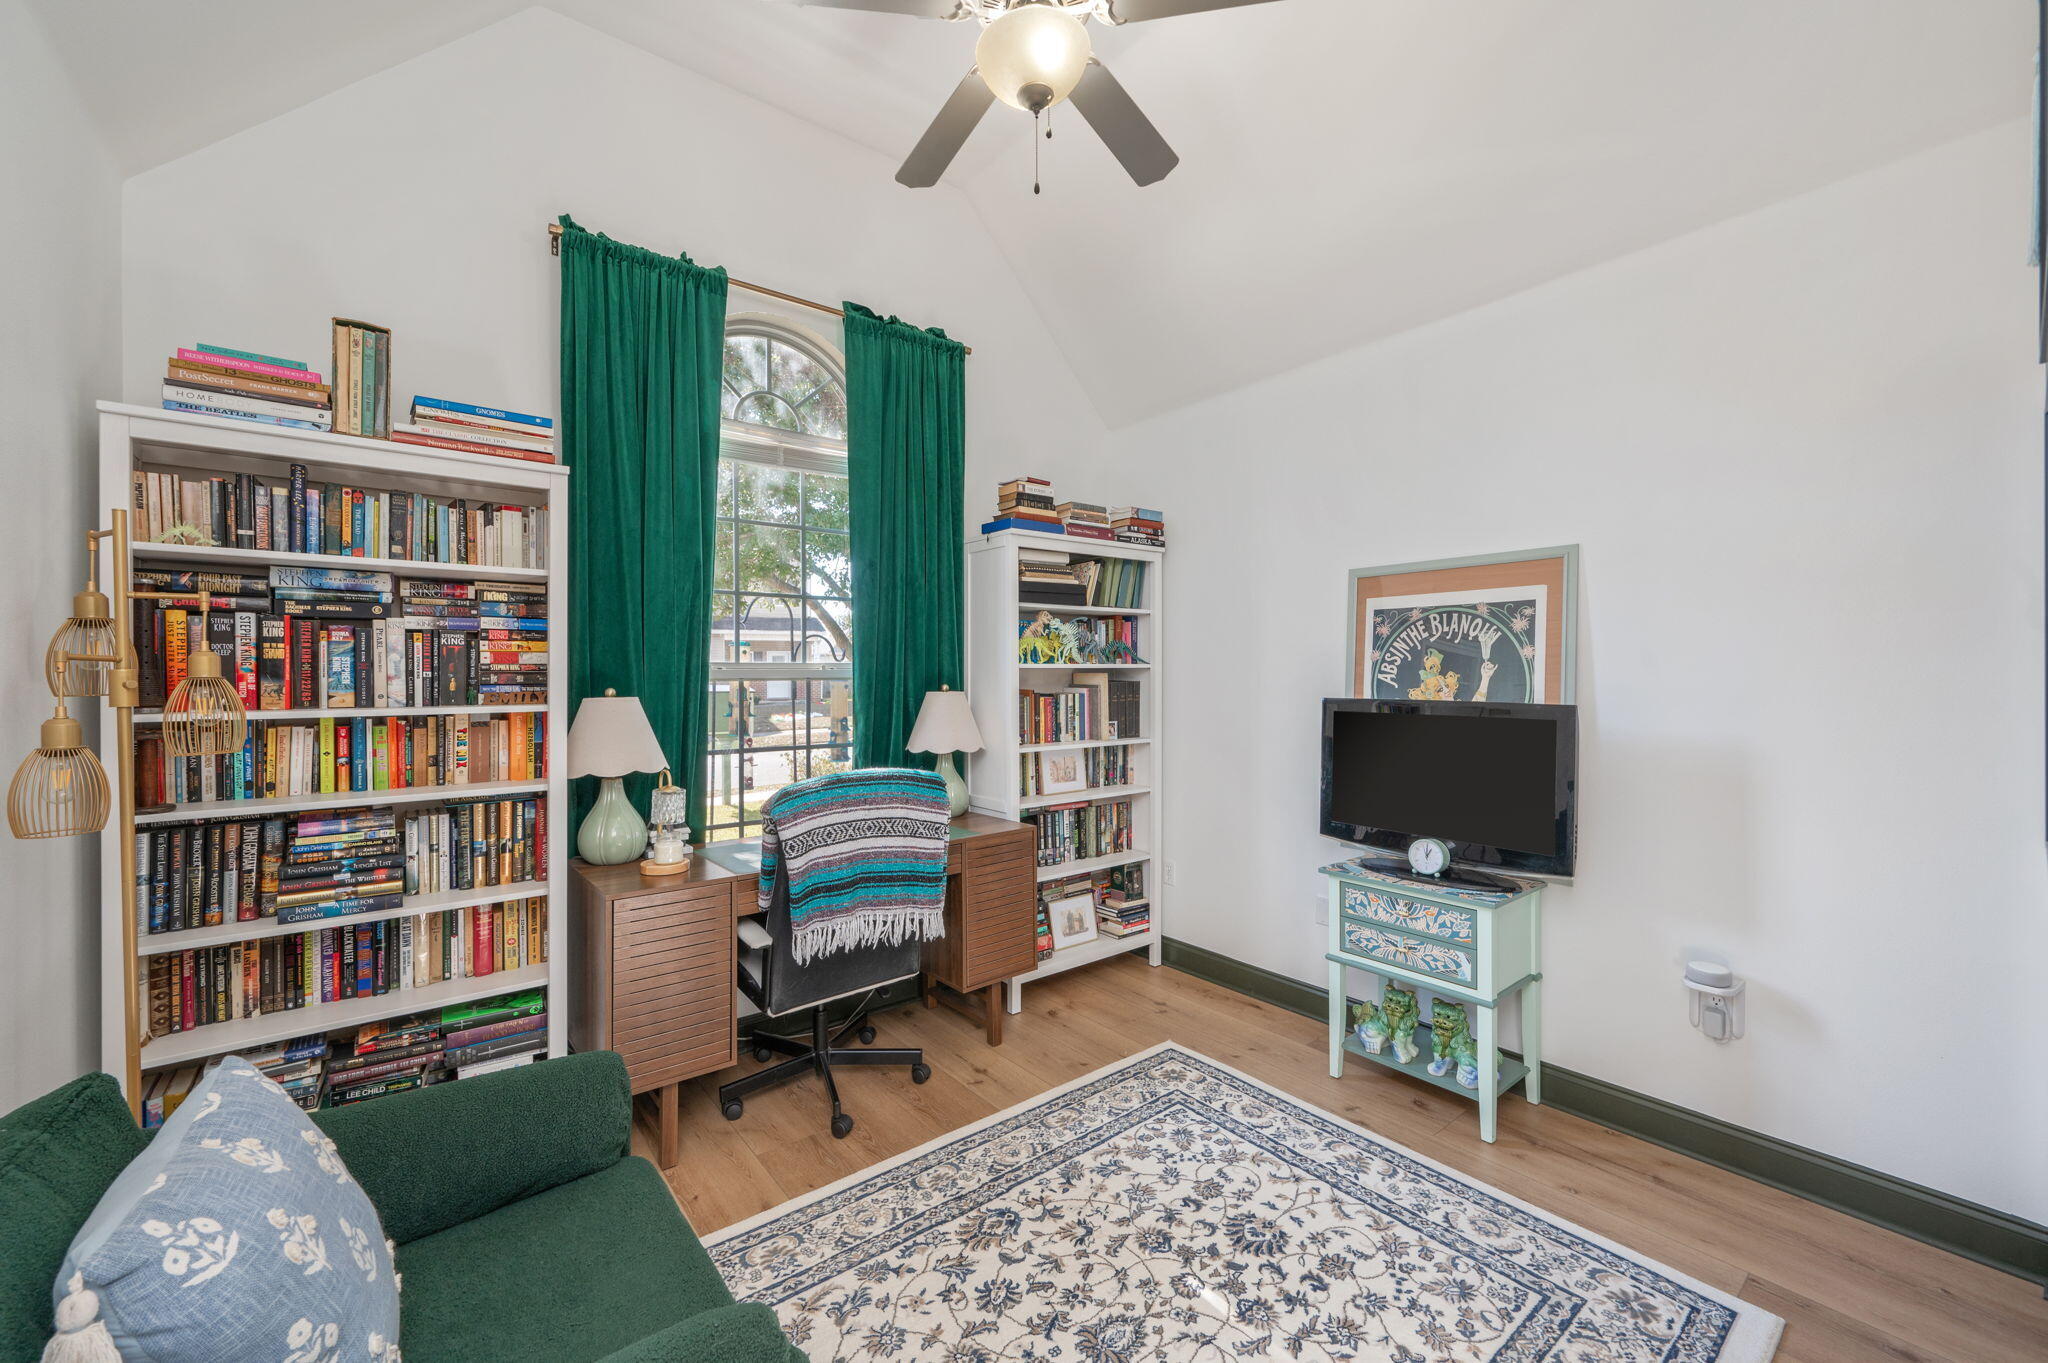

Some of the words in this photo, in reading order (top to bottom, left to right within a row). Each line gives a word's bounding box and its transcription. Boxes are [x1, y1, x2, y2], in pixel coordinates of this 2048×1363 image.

[203, 355, 250, 368] WITHERSPOON
[178, 369, 236, 386] PostSecret
[270, 376, 316, 389] GHOSTS
[176, 401, 202, 411] THE
[205, 406, 258, 419] BEATLES
[475, 407, 506, 418] GNOMES
[135, 482, 144, 510] PAPILLON
[1130, 536, 1152, 545] ALASKA
[133, 572, 172, 583] STEPHEN
[277, 567, 322, 577] STEPHEN
[198, 581, 242, 593] MIDNIGHT
[277, 575, 322, 588] KING
[410, 590, 441, 598] KING
[167, 620, 175, 637] JUST
[210, 617, 234, 625] STEPHEN
[213, 624, 231, 632] KING
[262, 620, 284, 628] STEPHEN
[239, 615, 252, 647] STEPHEN
[262, 627, 285, 637] KING
[301, 621, 312, 647] STEPHEN
[376, 628, 384, 649] PEARL
[176, 620, 186, 664] STEPHEN
[167, 640, 175, 662] AFTER
[240, 648, 252, 666] KING
[301, 649, 312, 663] KING
[1377, 620, 1428, 689] ABSINTHE
[332, 656, 342, 672] KING
[341, 656, 351, 684] STEPHEN
[167, 665, 175, 691] SUNSE
[456, 727, 468, 747] THE
[456, 749, 468, 768] NIX
[173, 833, 181, 845] THE
[211, 829, 221, 844] JOHN
[227, 828, 237, 839] THE
[243, 825, 258, 842] JOHN
[265, 825, 275, 851] GRISHAM
[274, 830, 282, 845] JOHN
[460, 827, 470, 846] FIRM
[192, 839, 202, 867] BROKER
[295, 845, 310, 853] John
[310, 843, 333, 852] Grisham
[173, 847, 181, 870] APPEAL
[211, 845, 220, 871] GRISHAM
[242, 842, 257, 871] GRISHAM
[243, 873, 255, 884] THE
[287, 867, 306, 876] JOHN
[308, 865, 338, 873] GRISHAM
[356, 874, 387, 883] WHISTLER
[173, 873, 181, 888] JOHN
[192, 878, 201, 896] JOHN
[282, 883, 302, 892] JOHN
[305, 880, 338, 889] GRISHAM
[156, 882, 165, 898] JOHN
[210, 877, 219, 904] ROOSTER
[243, 884, 255, 909] CHAMBER
[156, 898, 164, 923] GRISHAM
[173, 889, 181, 917] GRISHAM
[295, 906, 317, 914] JOHN
[341, 906, 367, 915] MERCY
[342, 900, 359, 908] TIME
[192, 897, 201, 927] GRISHAM
[287, 911, 324, 922] GRISHAM
[323, 929, 333, 955] HAUNTED
[343, 926, 354, 964] BLACKWATER
[402, 933, 411, 948] DAWN
[323, 959, 333, 993] PALAHNIUK
[346, 1090, 361, 1099] LEE
[361, 1086, 386, 1096] CHILD
